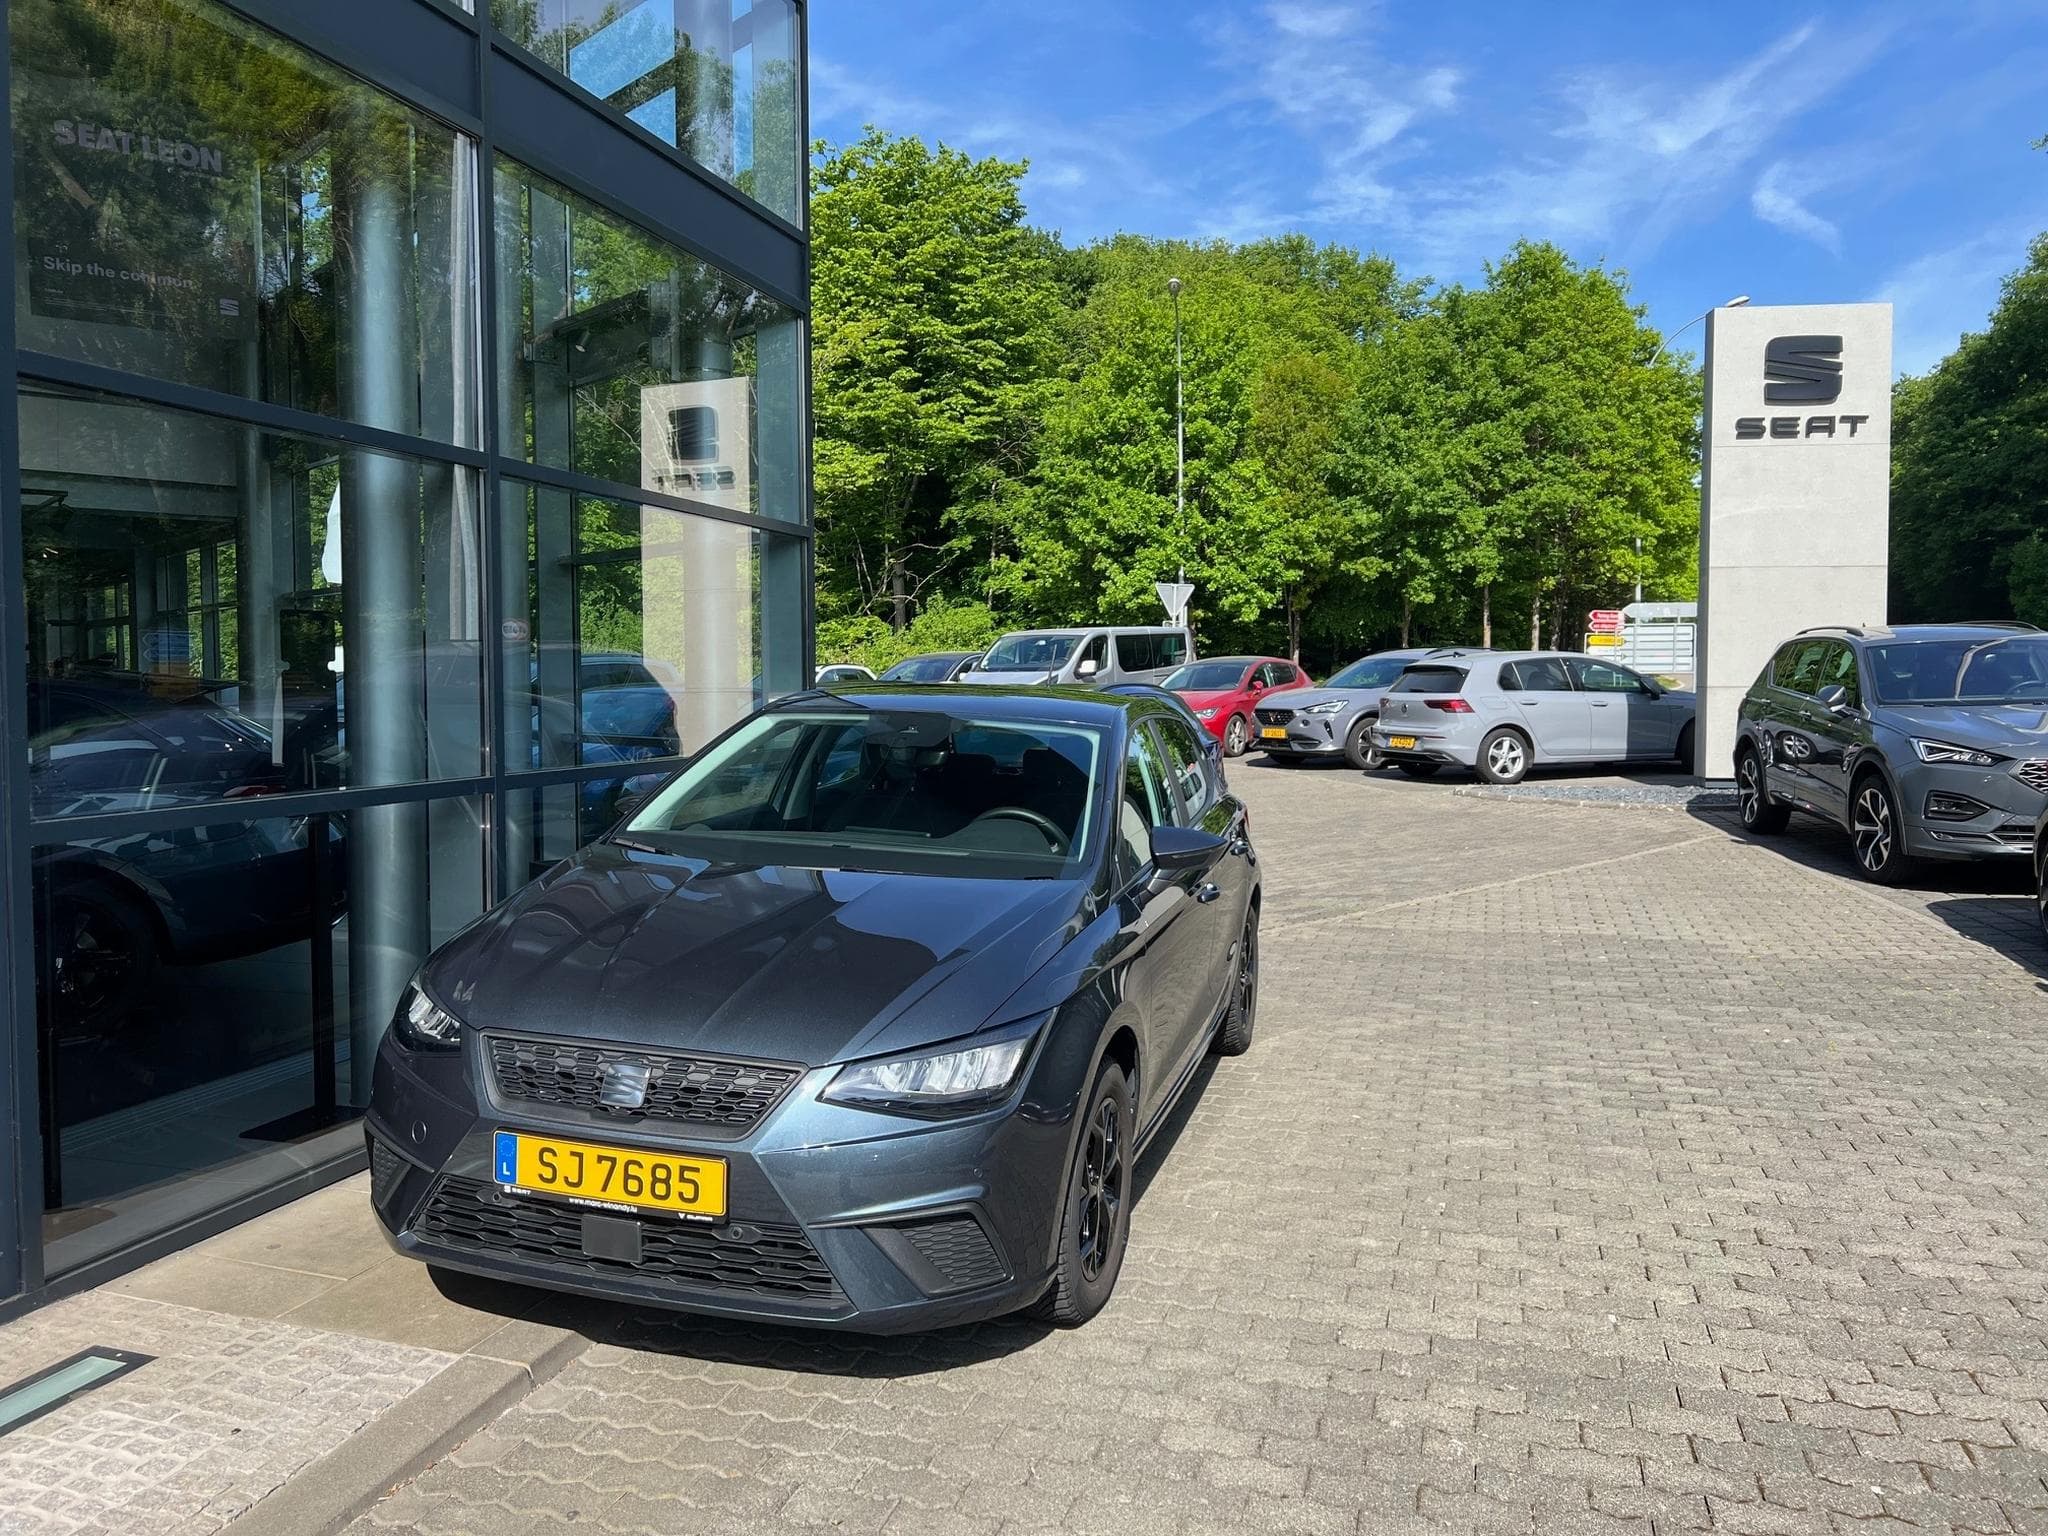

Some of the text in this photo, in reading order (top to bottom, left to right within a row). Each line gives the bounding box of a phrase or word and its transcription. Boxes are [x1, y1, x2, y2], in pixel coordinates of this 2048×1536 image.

[53, 119, 223, 173] SEAT LEON
[43, 255, 82, 277] Skip
[86, 262, 116, 279] the
[1735, 415, 1869, 440] SEAT
[502, 1161, 510, 1176] L
